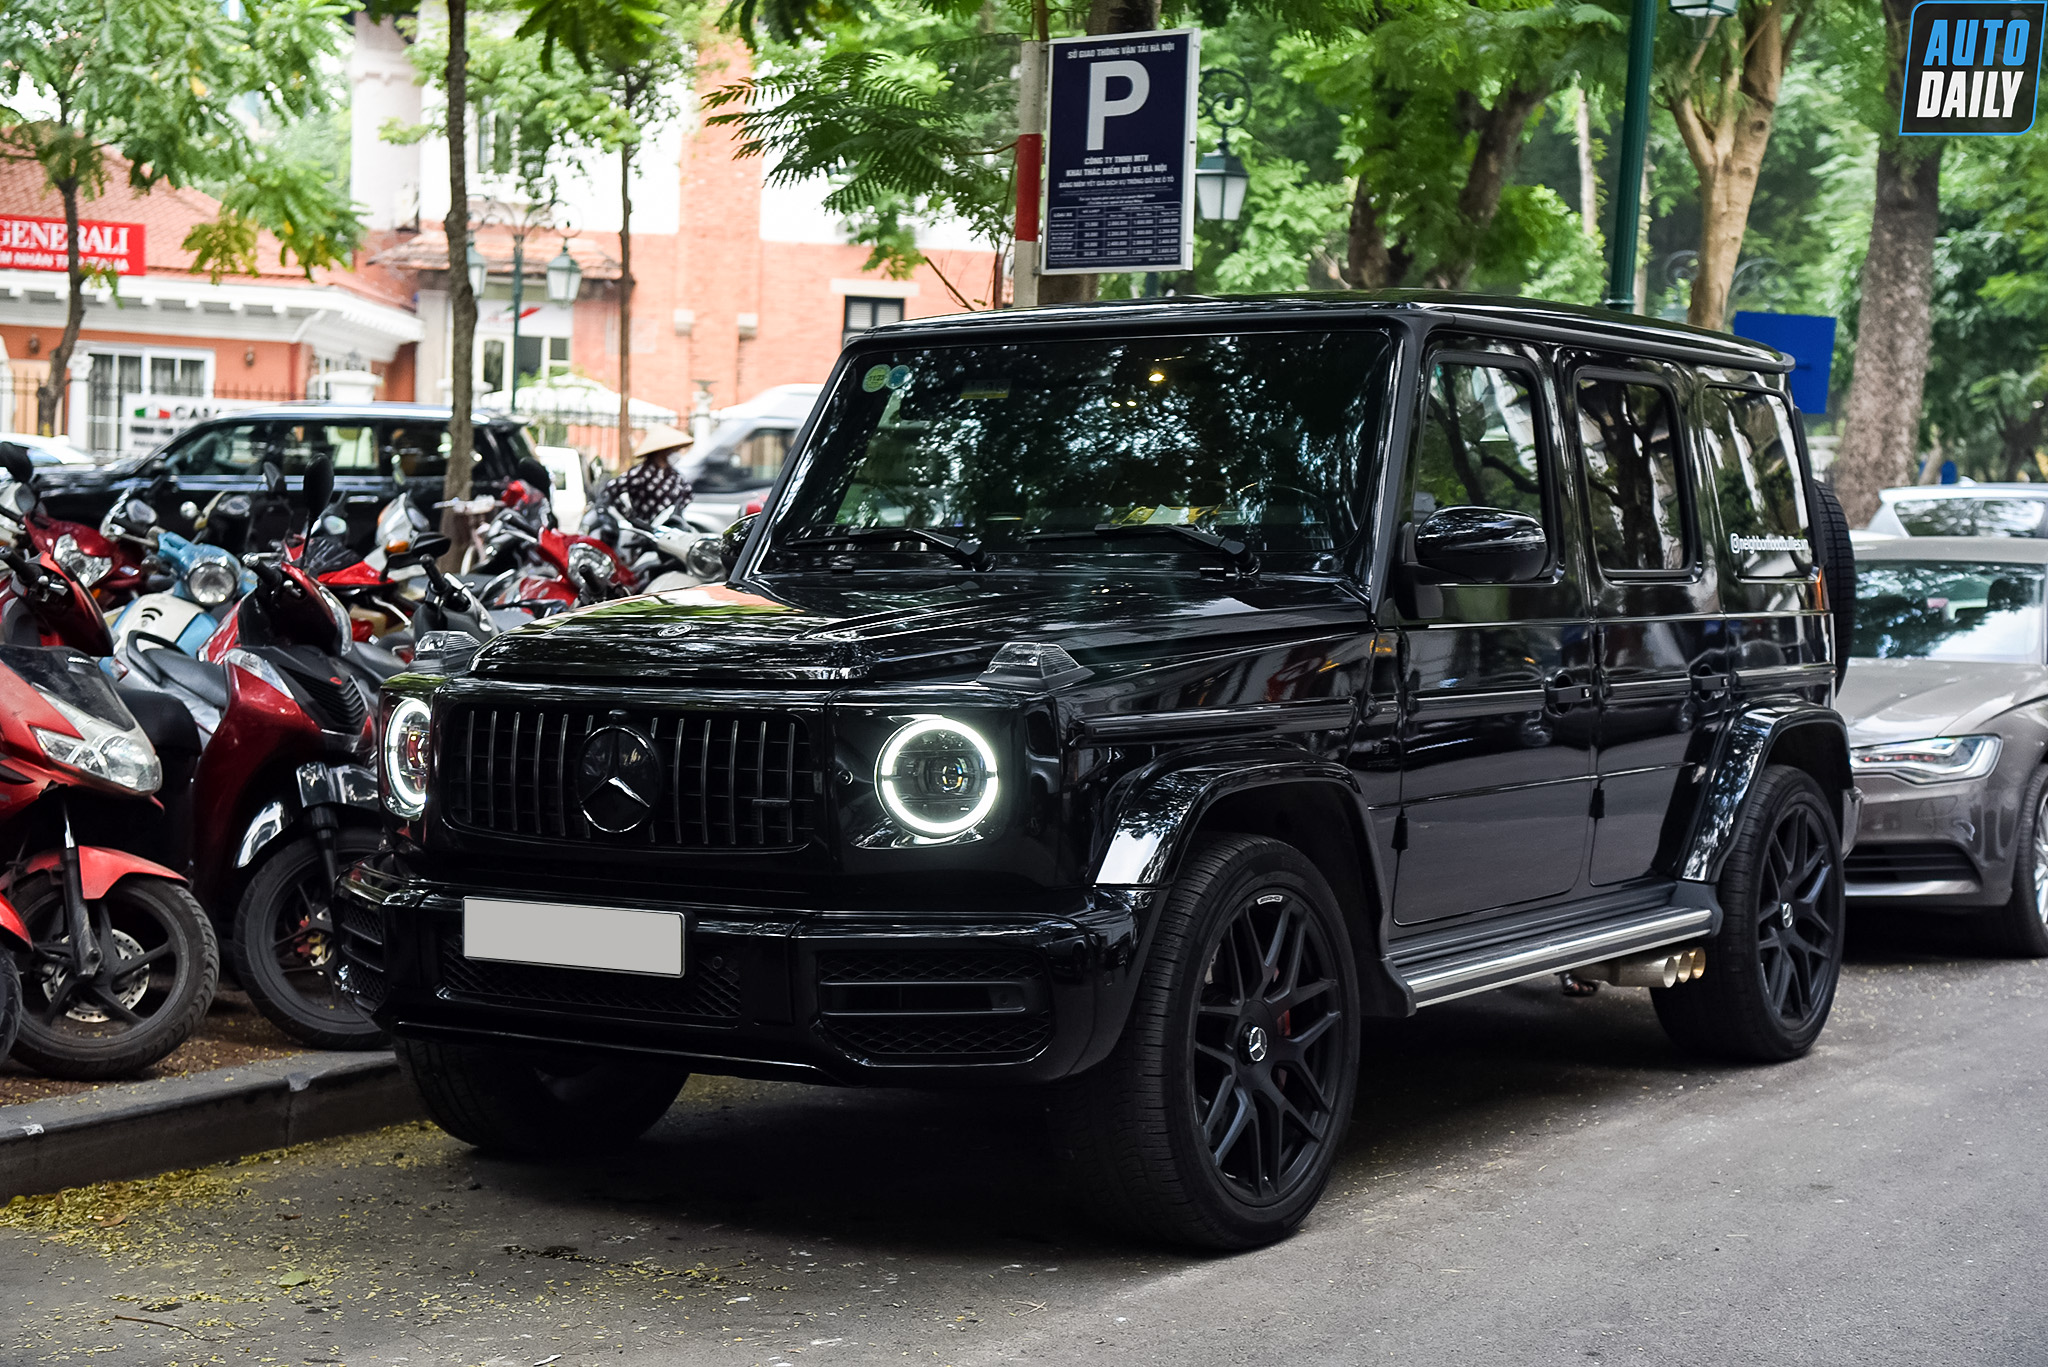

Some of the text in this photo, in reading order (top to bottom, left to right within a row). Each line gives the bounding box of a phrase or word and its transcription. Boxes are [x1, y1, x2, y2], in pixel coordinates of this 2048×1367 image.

[1079, 49, 1095, 58] GIAO
[1097, 47, 1120, 56] THÔNG
[1150, 42, 1160, 52] HÀ
[1161, 42, 1175, 52] NỘI
[1087, 60, 1150, 150] P
[1084, 156, 1103, 165] CÔNG
[1066, 169, 1082, 177] KHAI
[1132, 165, 1142, 173] XE
[1143, 164, 1153, 173] HÀ
[1154, 163, 1168, 173] NỘI
[0, 219, 129, 255] GENERALI
